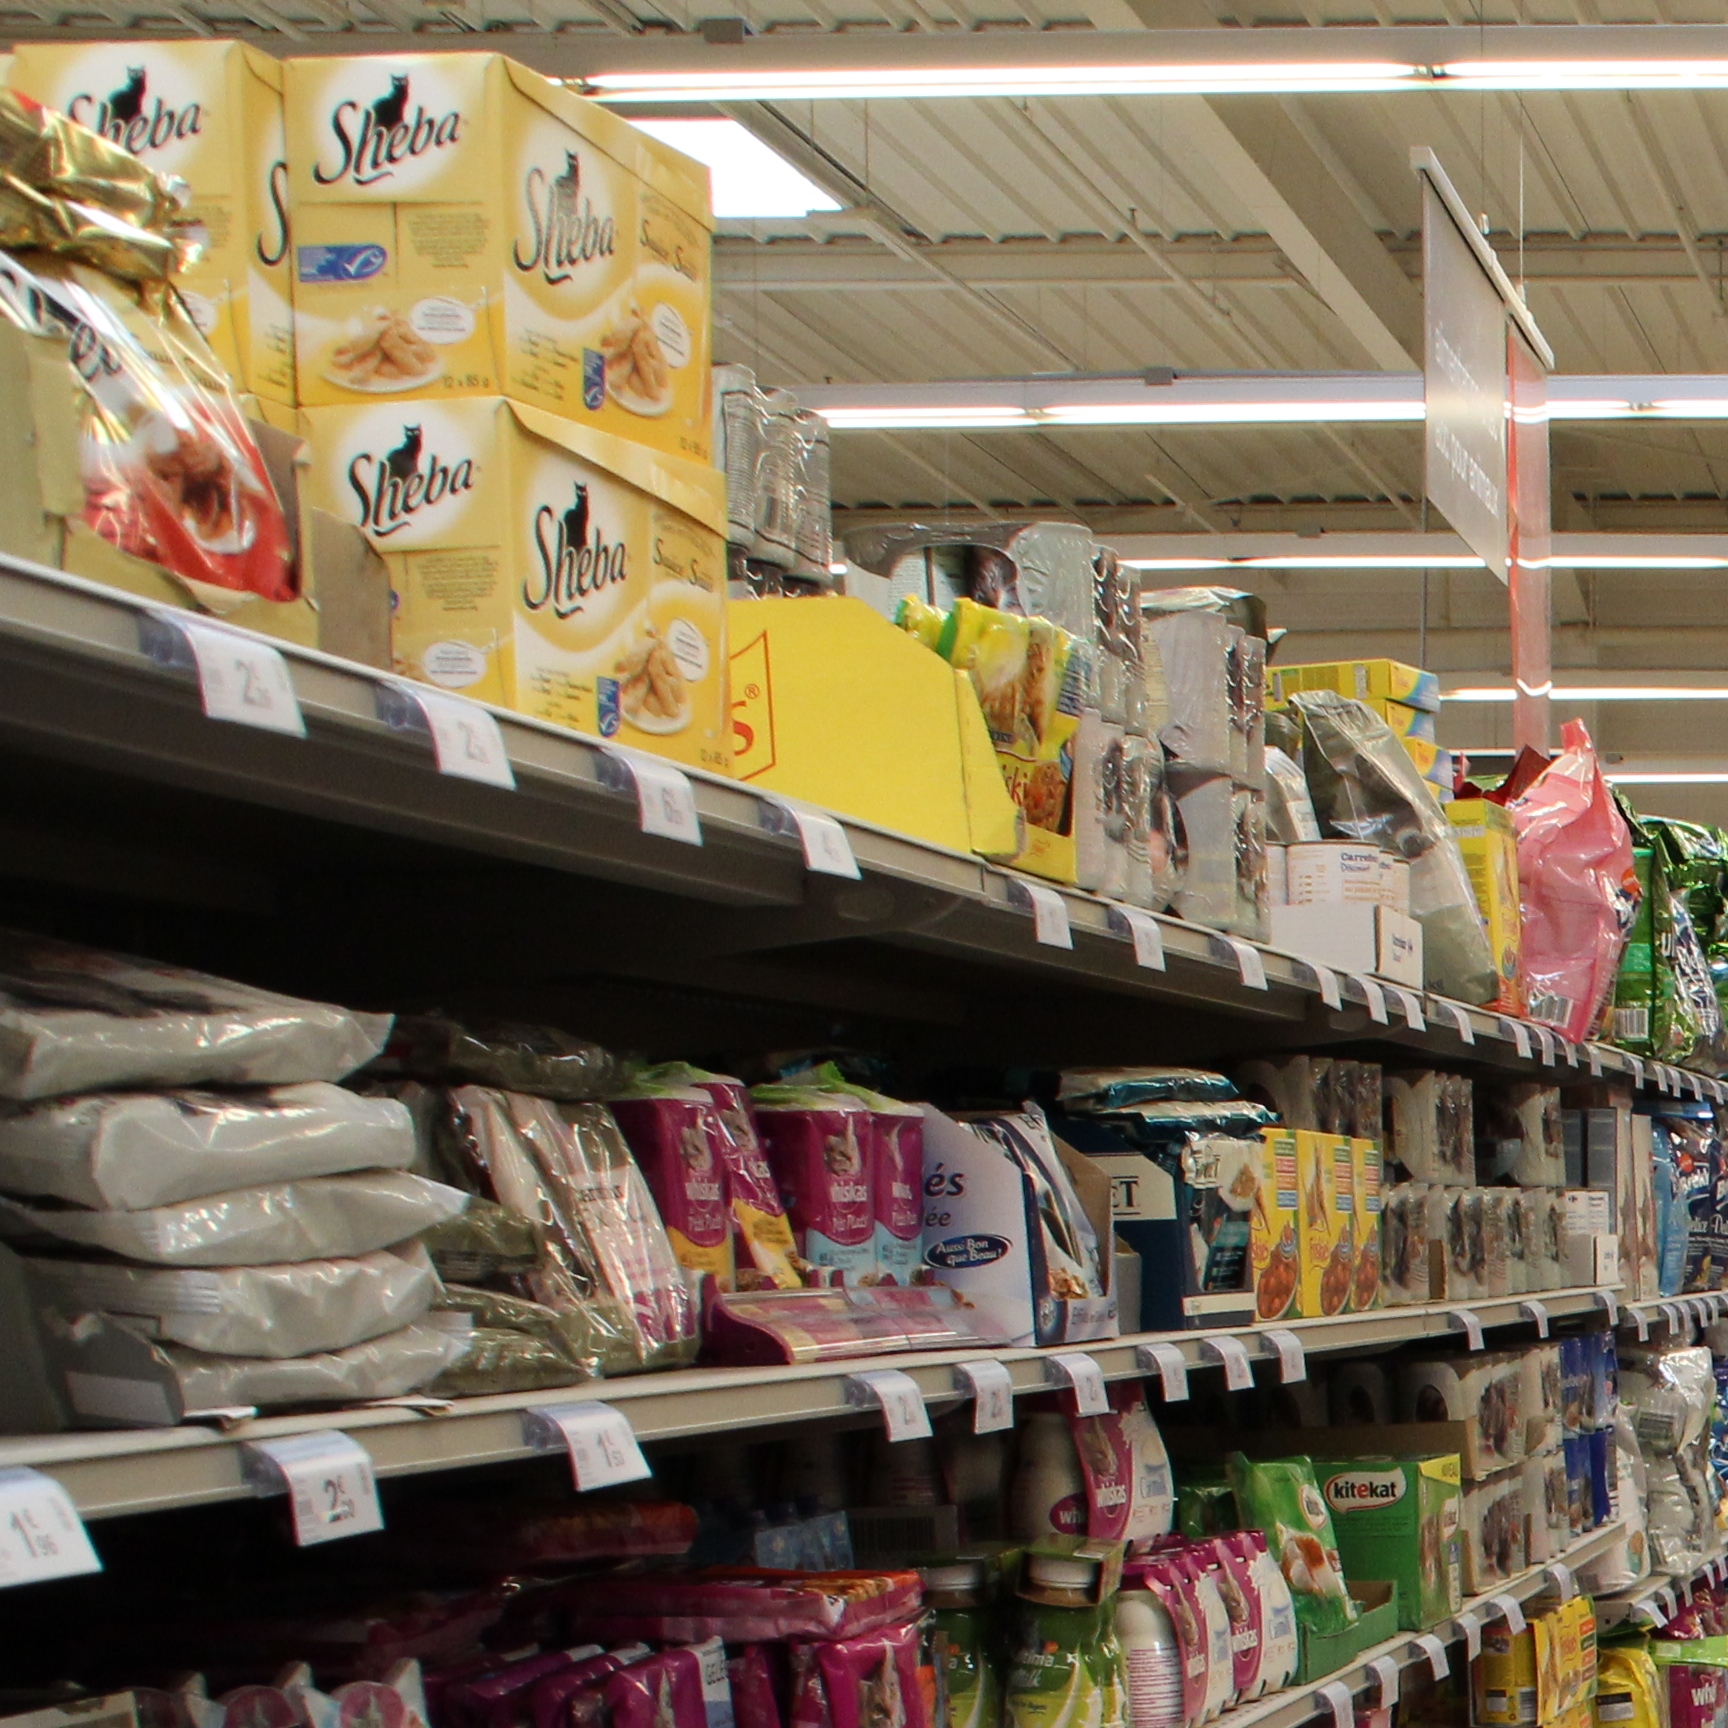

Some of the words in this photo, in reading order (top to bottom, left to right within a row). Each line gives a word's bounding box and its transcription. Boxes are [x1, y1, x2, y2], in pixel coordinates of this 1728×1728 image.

[313, 100, 463, 187] Sheba
[514, 167, 618, 286] Sheba
[348, 450, 475, 537] Sheba
[523, 505, 628, 620] Sheba
[946, 1250, 969, 1266] que
[966, 1237, 990, 1253] Bon
[1332, 1476, 1398, 1502] kitekat
